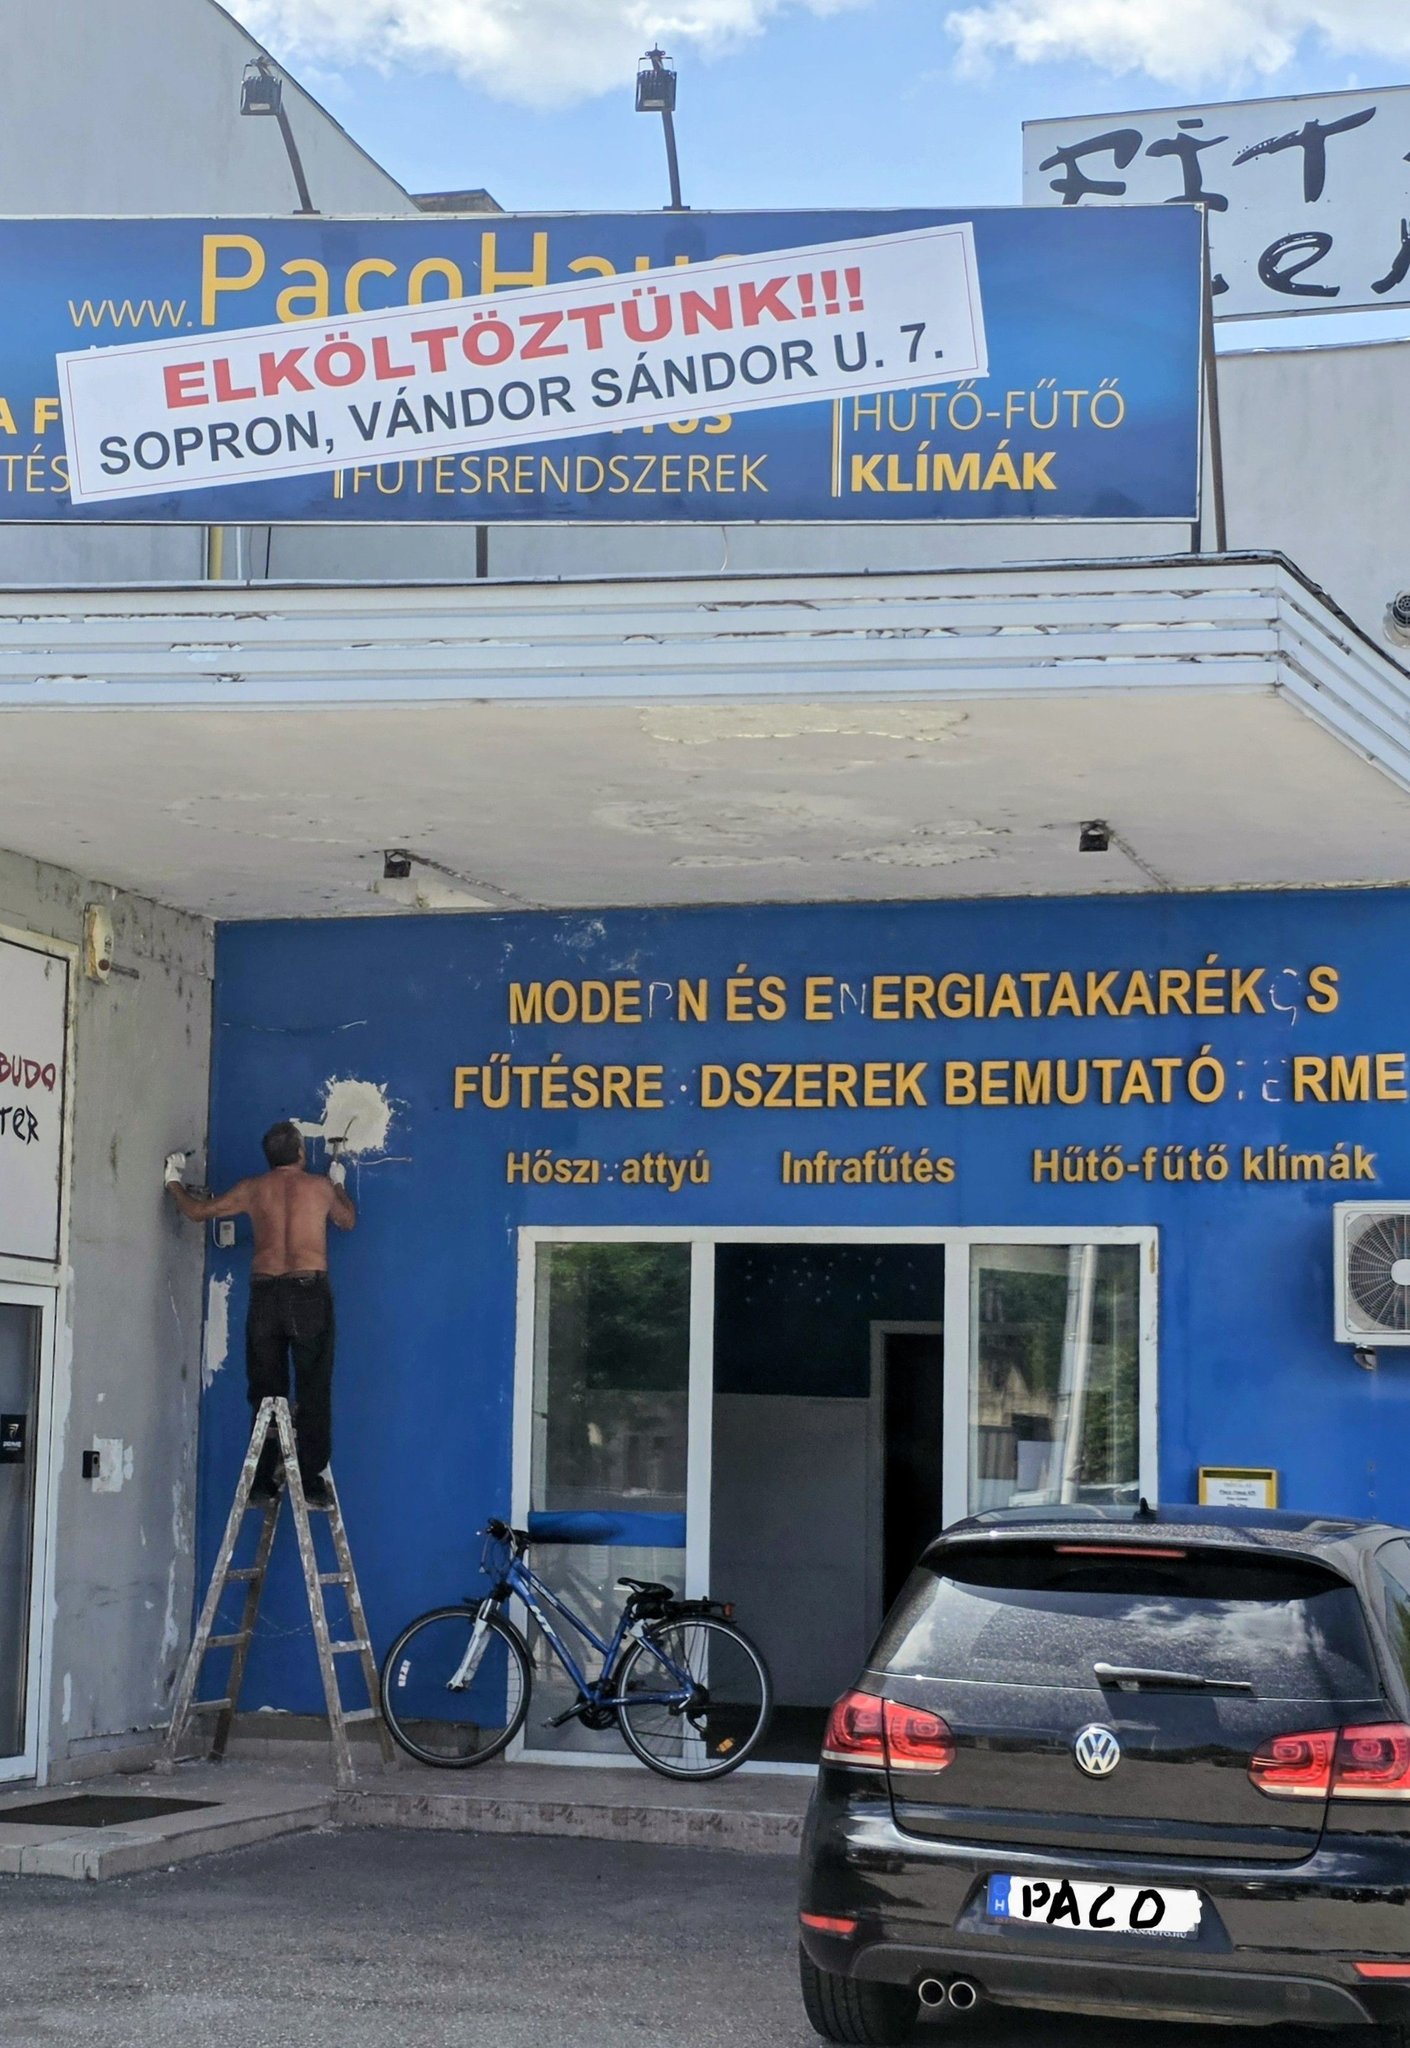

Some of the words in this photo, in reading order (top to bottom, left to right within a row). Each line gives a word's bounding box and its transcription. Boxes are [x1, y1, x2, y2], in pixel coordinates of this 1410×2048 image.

[164, 267, 864, 410] ELKÖLTÖZTÜNK!!!
[100, 410, 334, 476] SOPRON,
[347, 375, 577, 442] VÁNDOR
[591, 338, 820, 408] SÁNDOR
[833, 331, 885, 374] U.
[900, 322, 944, 364] 7.
[851, 439, 1057, 492] KLÍMÁK
[726, 964, 787, 1022] ÉS
[454, 1053, 928, 1109] FŰTÉSREDSZEREK
[507, 1150, 710, 1192] Hősziattyú
[783, 1146, 956, 1184] Infrafűtés
[1033, 1145, 1229, 1183] Hűtő-fűtő
[1244, 1143, 1376, 1181] klímák
[994, 1899, 1005, 1912] H
